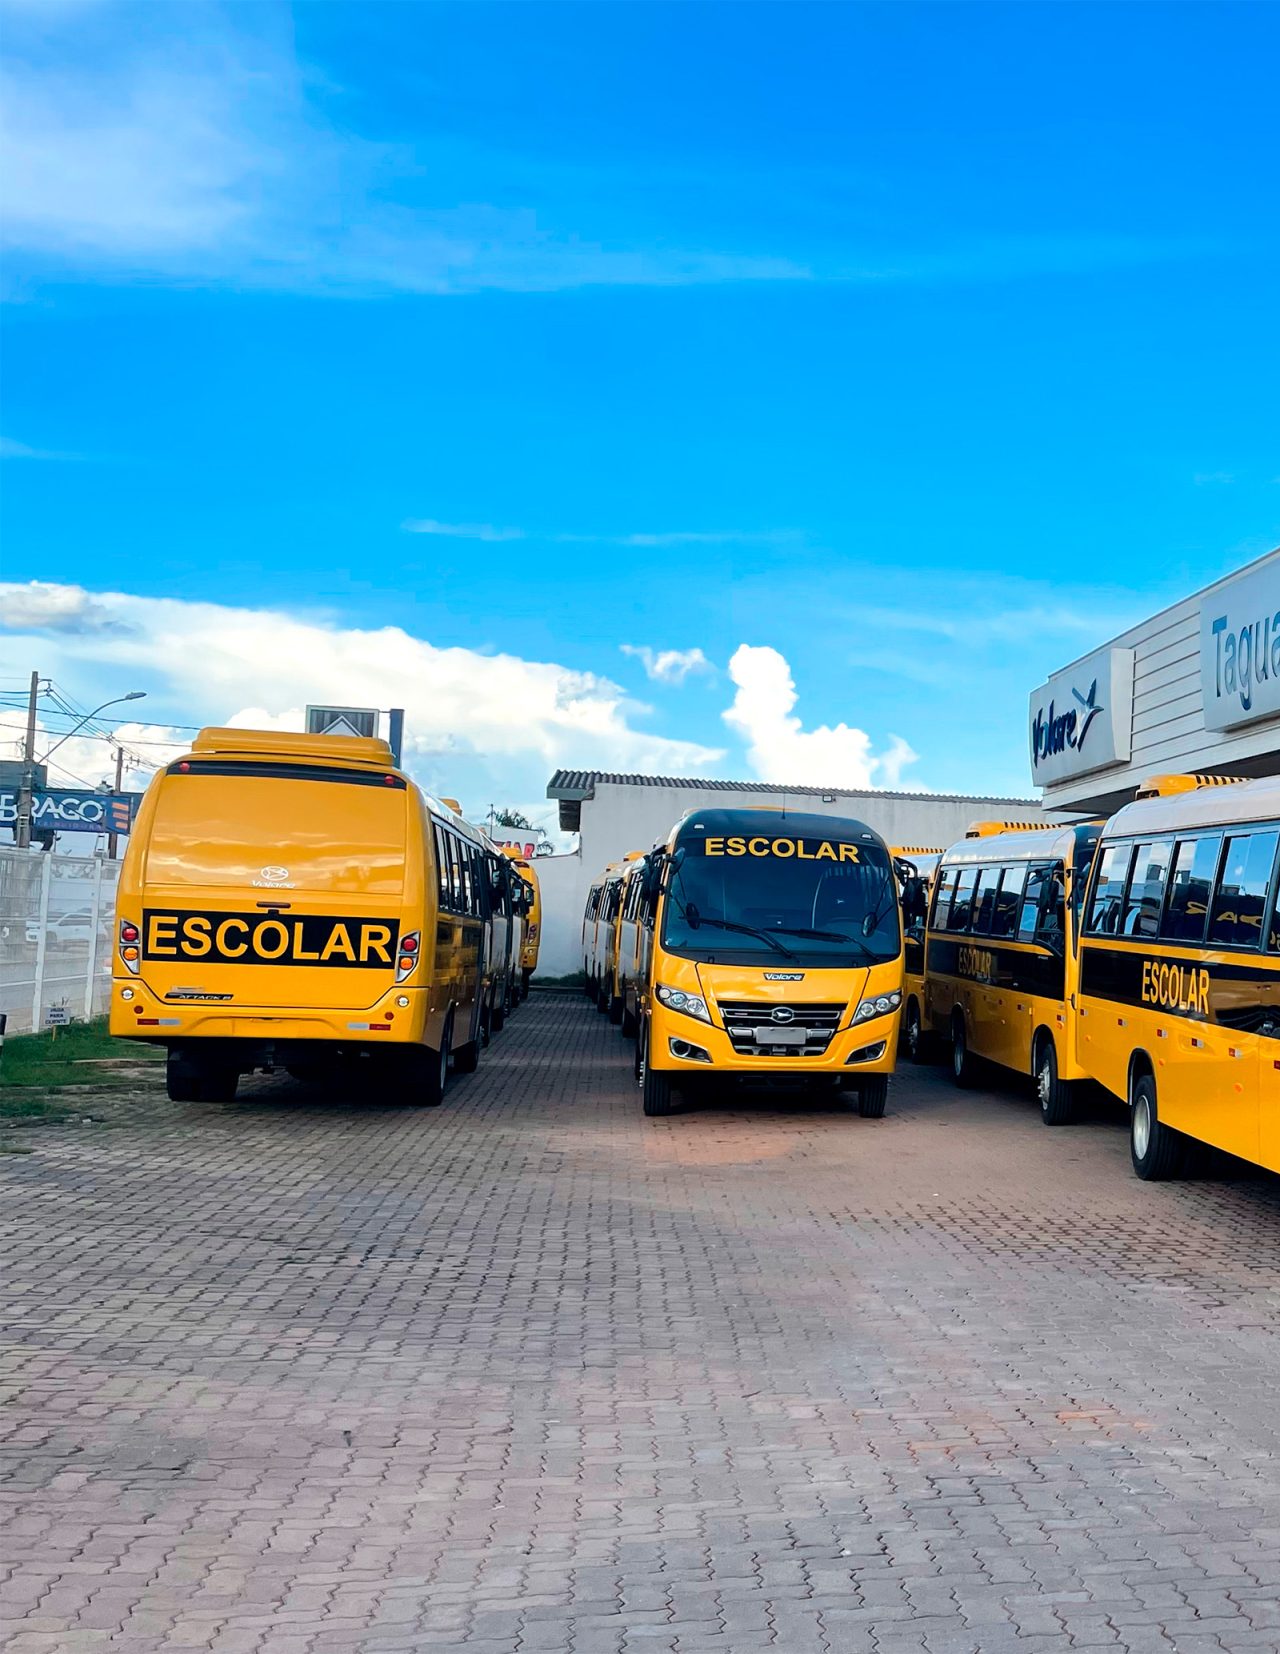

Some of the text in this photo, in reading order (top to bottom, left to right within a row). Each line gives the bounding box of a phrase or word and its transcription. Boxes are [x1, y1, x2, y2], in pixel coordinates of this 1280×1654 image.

[1033, 699, 1077, 768] Volare
[705, 837, 860, 864] ESCOLAR
[147, 915, 392, 962] ESCOLAR
[765, 973, 803, 981] Volare
[959, 947, 992, 979] ESCOLAR
[1141, 961, 1210, 1014] ESCOLAR
